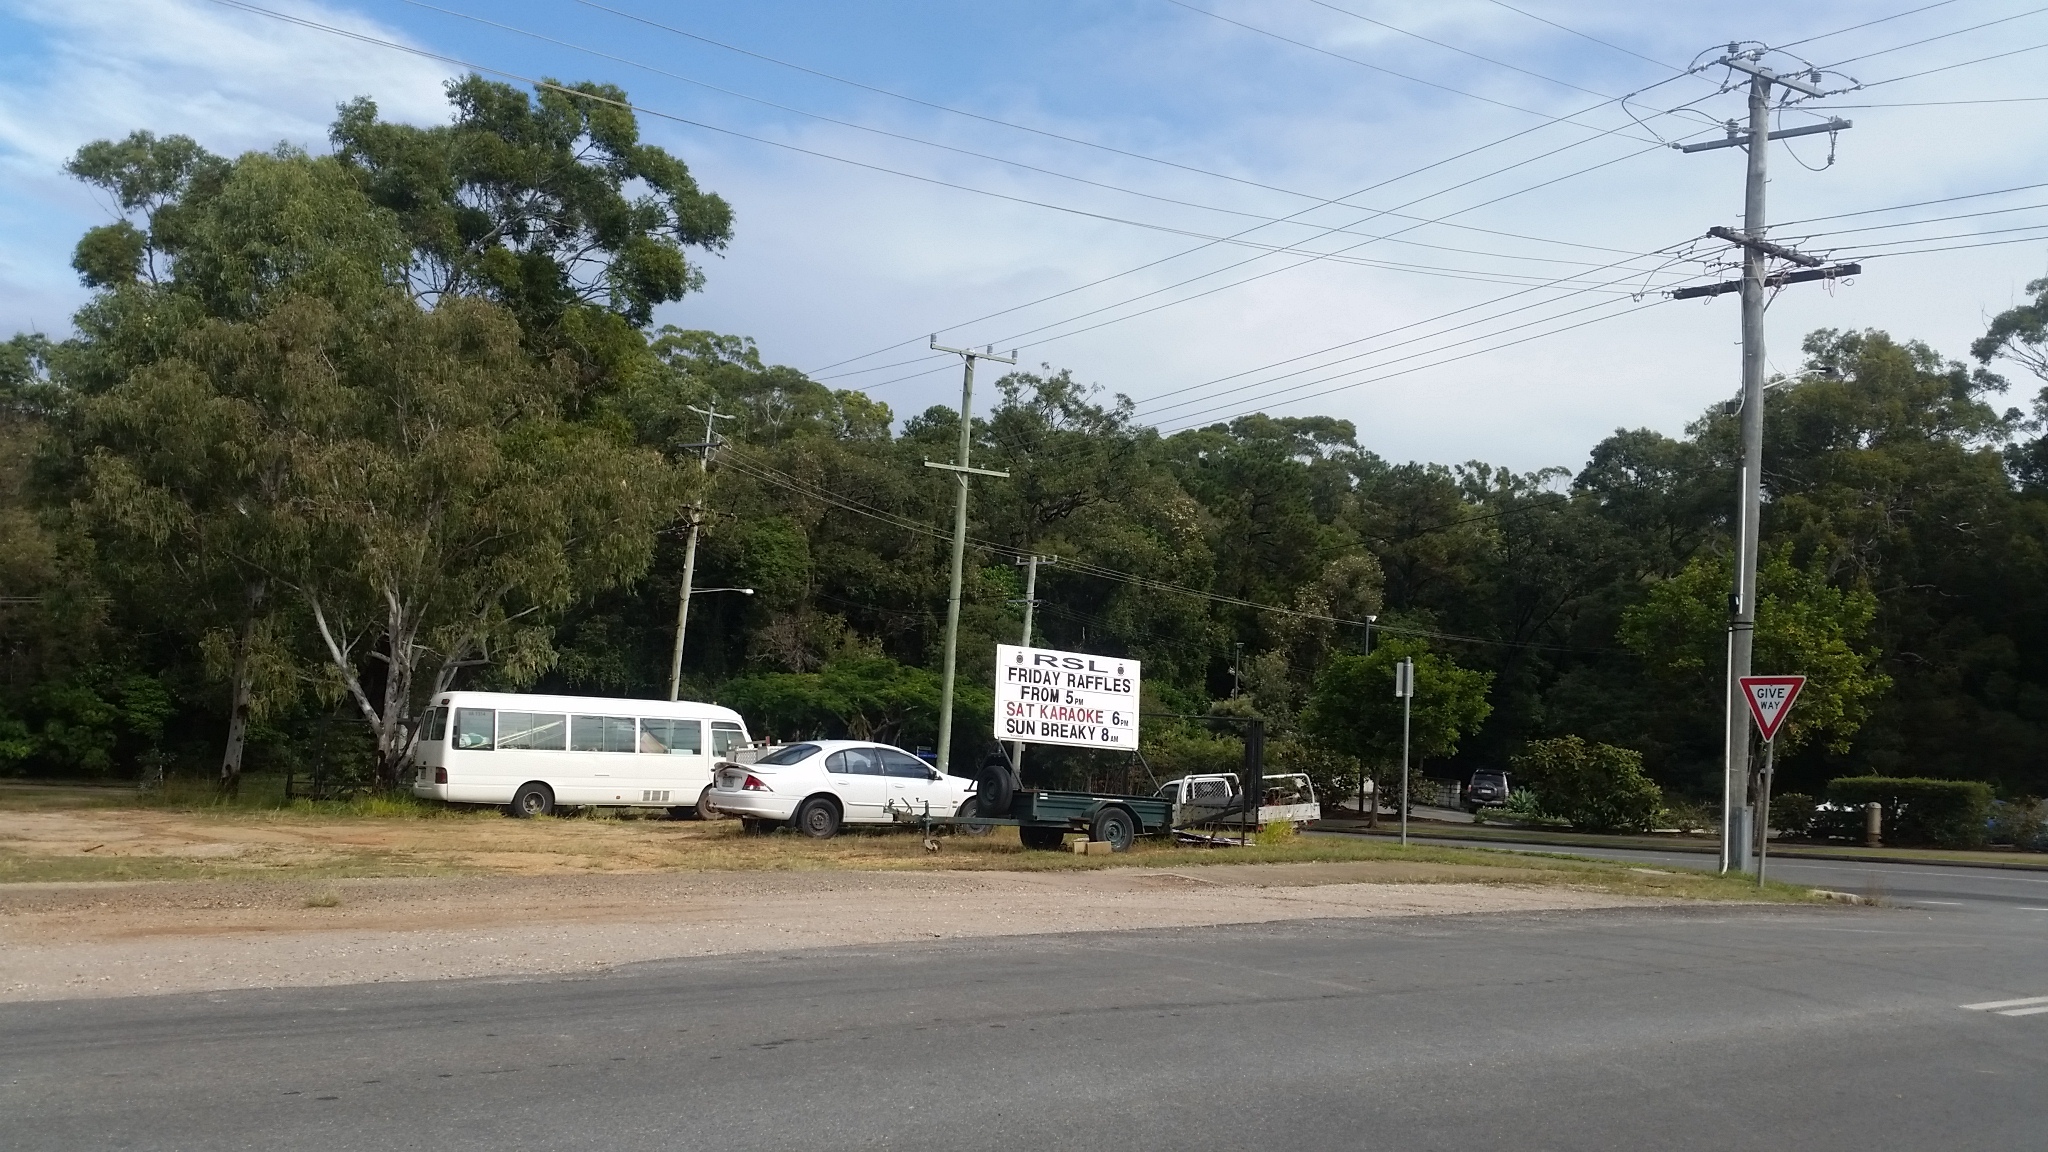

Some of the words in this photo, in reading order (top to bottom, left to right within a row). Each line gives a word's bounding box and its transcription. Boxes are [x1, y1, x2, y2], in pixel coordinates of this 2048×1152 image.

[1034, 654, 1108, 673] RSL
[1008, 667, 1060, 686] FRIDAY
[1067, 674, 1131, 693] RAFFLES
[1021, 686, 1059, 703] FROM
[1757, 688, 1785, 699] GIVE
[1006, 702, 1035, 718] SAT
[1040, 705, 1104, 724] KARAOKE
[1761, 701, 1780, 710] WAY
[1006, 718, 1036, 735] SUN
[1041, 722, 1096, 740] BREAKY
